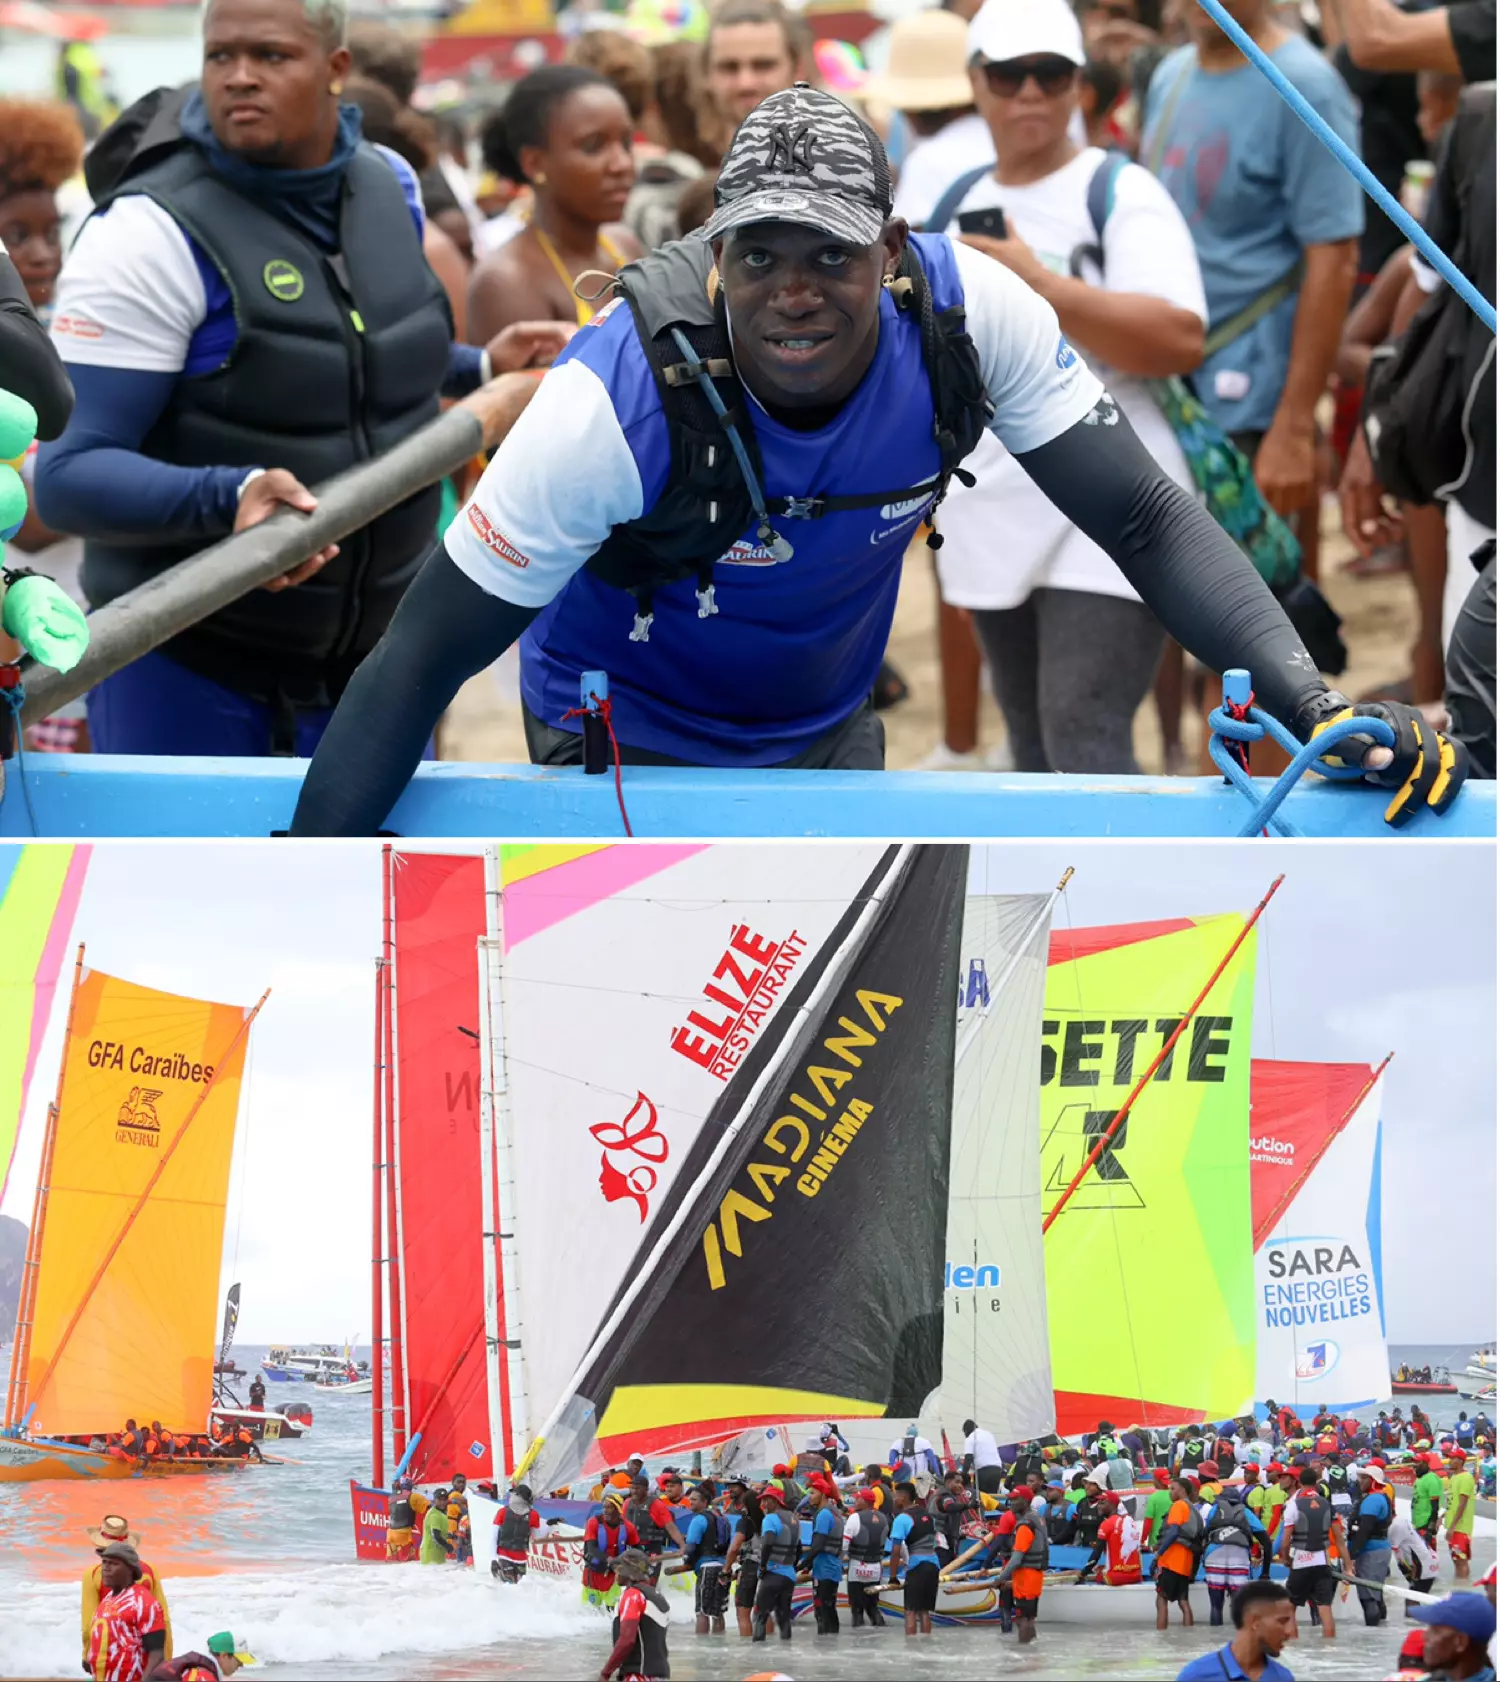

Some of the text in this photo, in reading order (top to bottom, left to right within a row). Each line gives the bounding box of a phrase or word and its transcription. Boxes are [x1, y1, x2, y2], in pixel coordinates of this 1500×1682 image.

[722, 548, 775, 561] AURIN
[711, 930, 808, 1082] RESTAURANT
[87, 1040, 215, 1084] GFA Caraïbes
[115, 1130, 160, 1149] GENERALI
[703, 989, 904, 1290] MADIANA
[797, 1098, 874, 1198] CINÉMA
[1249, 1136, 1295, 1155] ution
[1268, 1244, 1361, 1279] SARA
[1263, 1273, 1369, 1306] ENERGIES
[1265, 1295, 1371, 1328] NOUVELLES
